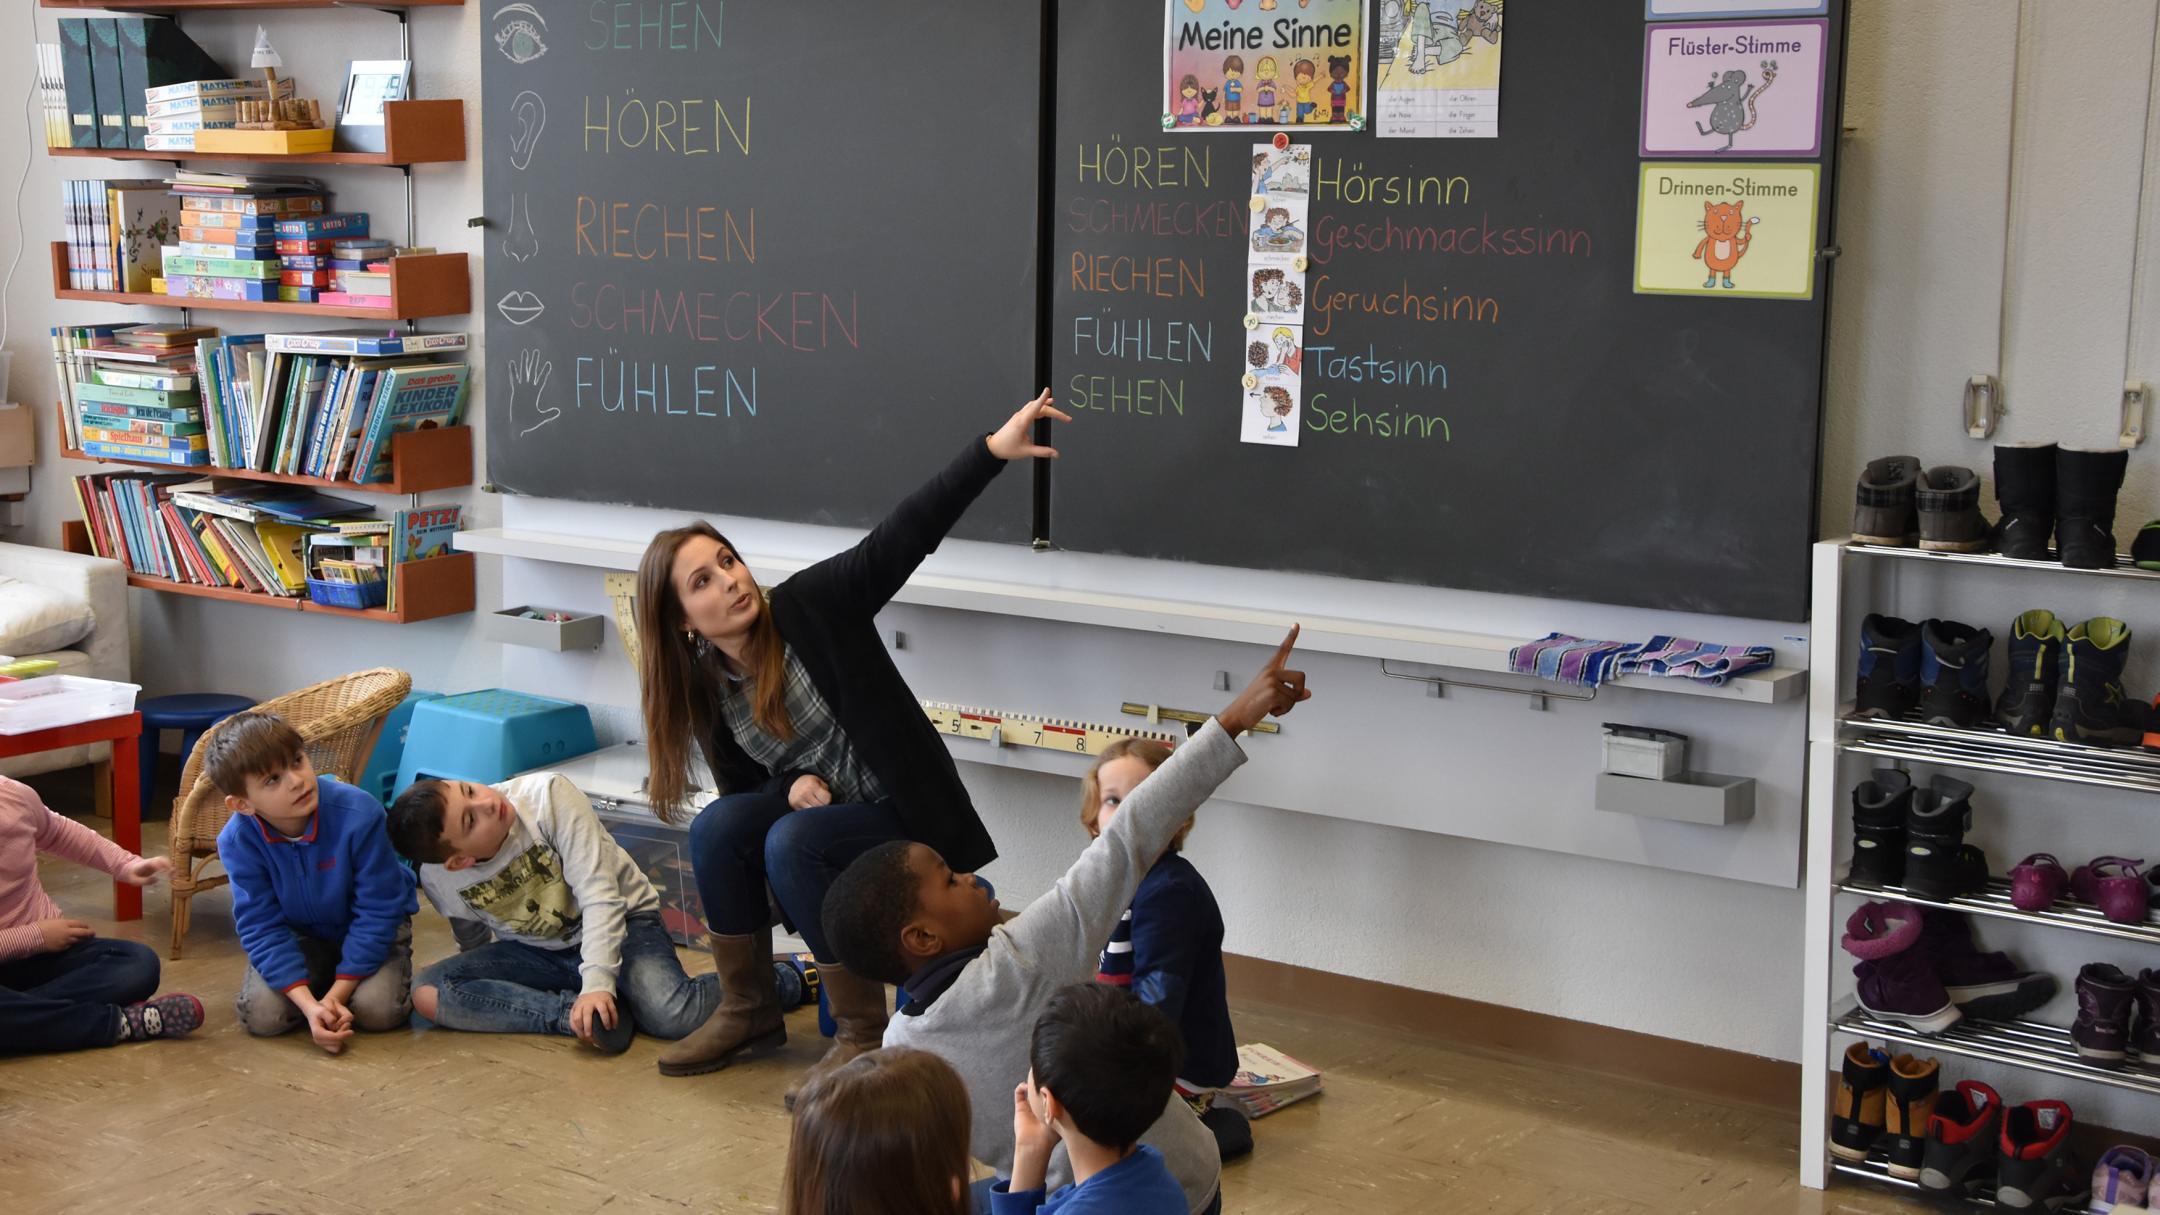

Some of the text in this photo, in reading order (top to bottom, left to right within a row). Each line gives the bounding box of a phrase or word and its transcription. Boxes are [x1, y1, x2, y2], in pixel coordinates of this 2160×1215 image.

[584, 0, 723, 50] SEHEN
[1179, 18, 1351, 51] Meine Sinne
[1668, 35, 1801, 56] Flüster-Stimme
[585, 87, 750, 155] HÖREN
[1079, 134, 1210, 189] HÖREN
[1316, 157, 1470, 205] Hörsinn
[1659, 176, 1798, 197] Drinnen-Stimme
[576, 196, 757, 264] RIECHEN
[1069, 197, 1250, 238] SCHMECKEN
[1310, 211, 1591, 264] Geschmackssinn
[1072, 251, 1204, 298] RIECHEN
[570, 281, 858, 351] SCHMECKEN
[1312, 275, 1498, 335] Geruchsinn
[1075, 307, 1212, 362] FÜHLEN
[577, 347, 756, 417] FÜHLEN
[1305, 344, 1447, 389] Tastsinn
[390, 398, 455, 416] LEXIKON
[396, 385, 458, 404] KINDER
[1069, 374, 1184, 416] SEHEN
[110, 431, 143, 444] Spielhaus
[1306, 393, 1450, 442] Sehsinn
[408, 507, 458, 530] PETZI
[951, 719, 959, 733] 5
[1033, 731, 1042, 746] 7
[1076, 737, 1084, 752] 8
